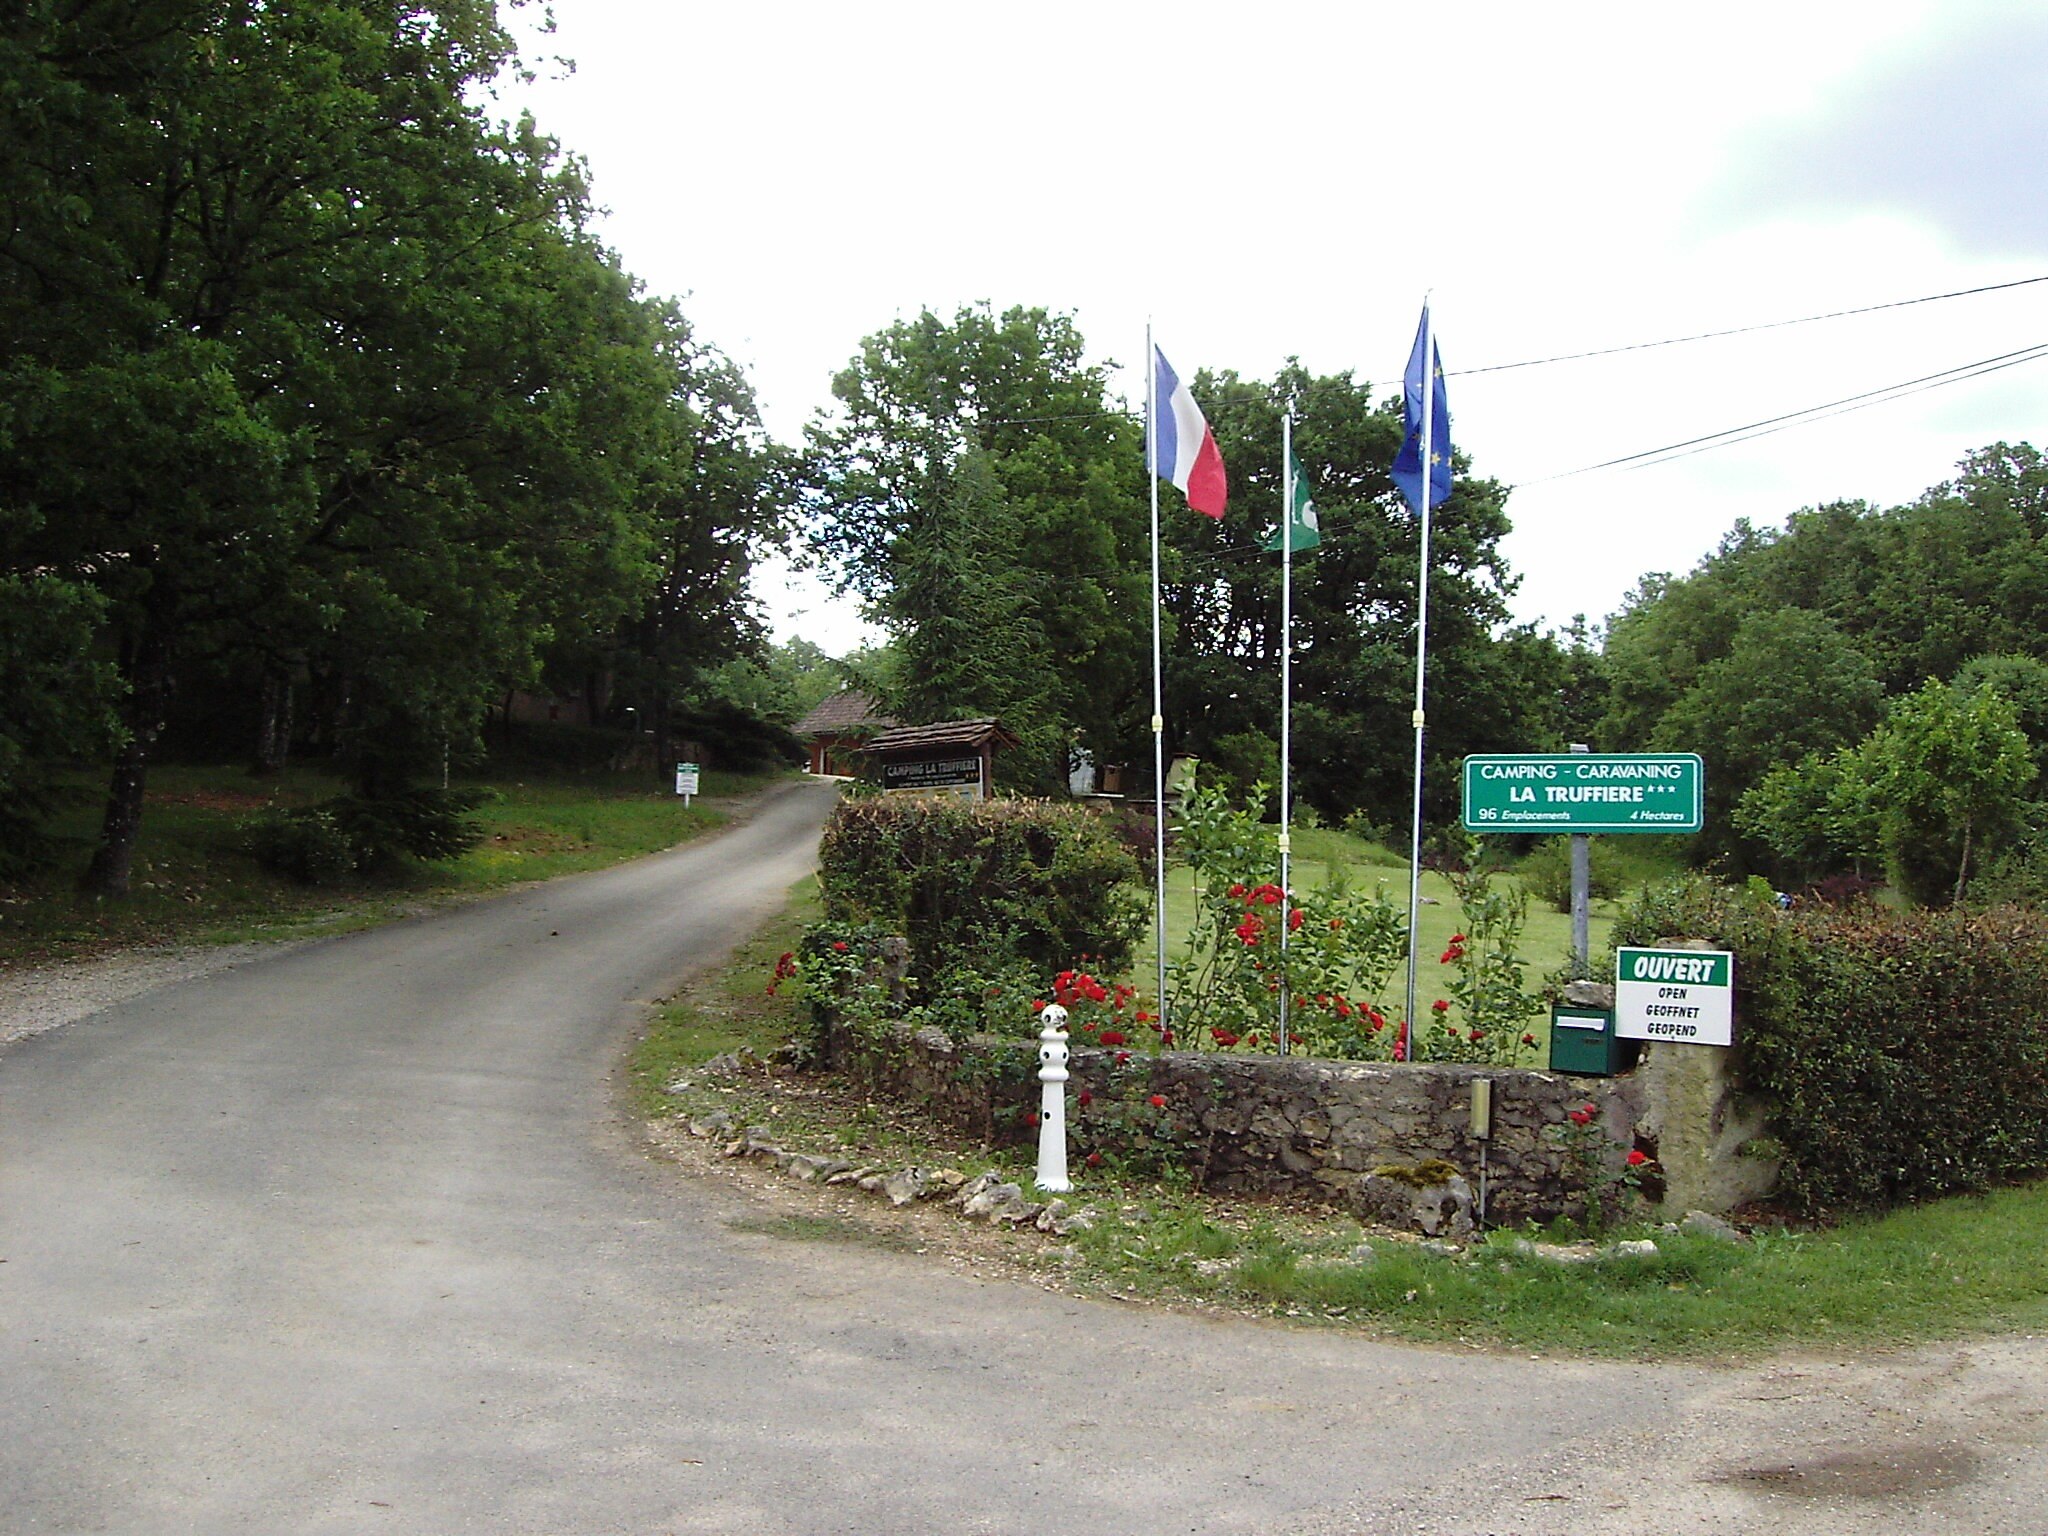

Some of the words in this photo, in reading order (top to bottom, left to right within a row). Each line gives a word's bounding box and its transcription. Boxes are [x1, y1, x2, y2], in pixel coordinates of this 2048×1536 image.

[1481, 764, 1557, 779] CAMPING
[1576, 764, 1682, 779] CARAVANING
[1510, 786, 1536, 802] LA
[1545, 786, 1644, 802] TRUFFIERE
[1478, 807, 1497, 820] 96
[1501, 809, 1571, 821] Emplacements
[1629, 810, 1638, 820] 4
[1640, 810, 1684, 821] Hectares
[1633, 955, 1715, 983] OUVERT
[1658, 987, 1688, 999] OPEN
[1645, 1004, 1700, 1019] GEOFFNET
[1647, 1022, 1697, 1037] GEOPEND
